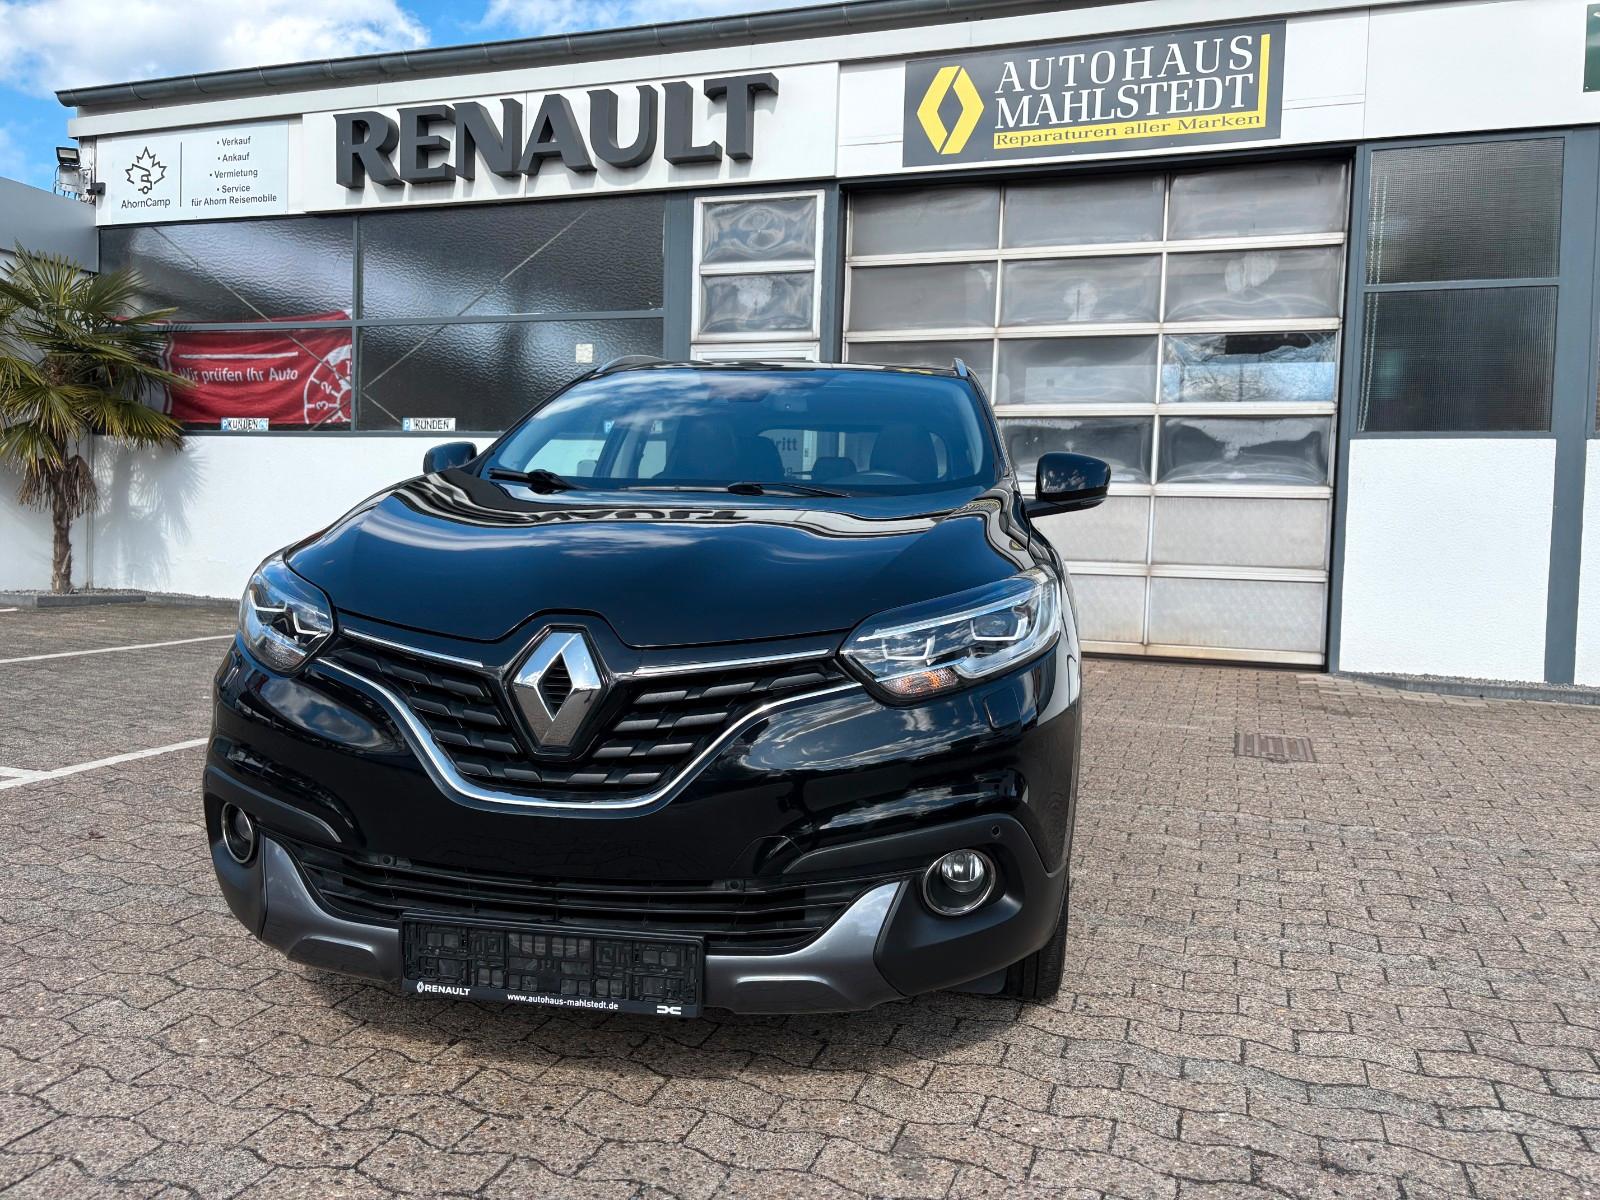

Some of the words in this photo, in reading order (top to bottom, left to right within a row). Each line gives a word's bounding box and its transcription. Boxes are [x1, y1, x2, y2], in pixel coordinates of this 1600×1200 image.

[994, 35, 1254, 94] AUTOHAUS
[994, 73, 1254, 129] MAHLSTEDT
[333, 72, 779, 189] RENAULT
[996, 125, 1117, 147] Reparaturen
[1124, 122, 1171, 136] aller
[1177, 114, 1261, 131] Marken
[221, 136, 251, 146] Verkauf
[222, 152, 250, 162] Ankauf
[214, 168, 258, 179] Vermietung
[221, 184, 251, 193] Service
[121, 198, 171, 209] AhornCamp
[191, 198, 203, 207] für
[204, 196, 227, 206] Ahorn
[229, 194, 277, 204] Reisemobile
[201, 367, 243, 384] prüfen
[246, 368, 264, 381] Ihr
[269, 367, 298, 381] Auto
[424, 984, 470, 996] RENAULT
[507, 993, 619, 1010] www.autohaus-mahlstedt.de
